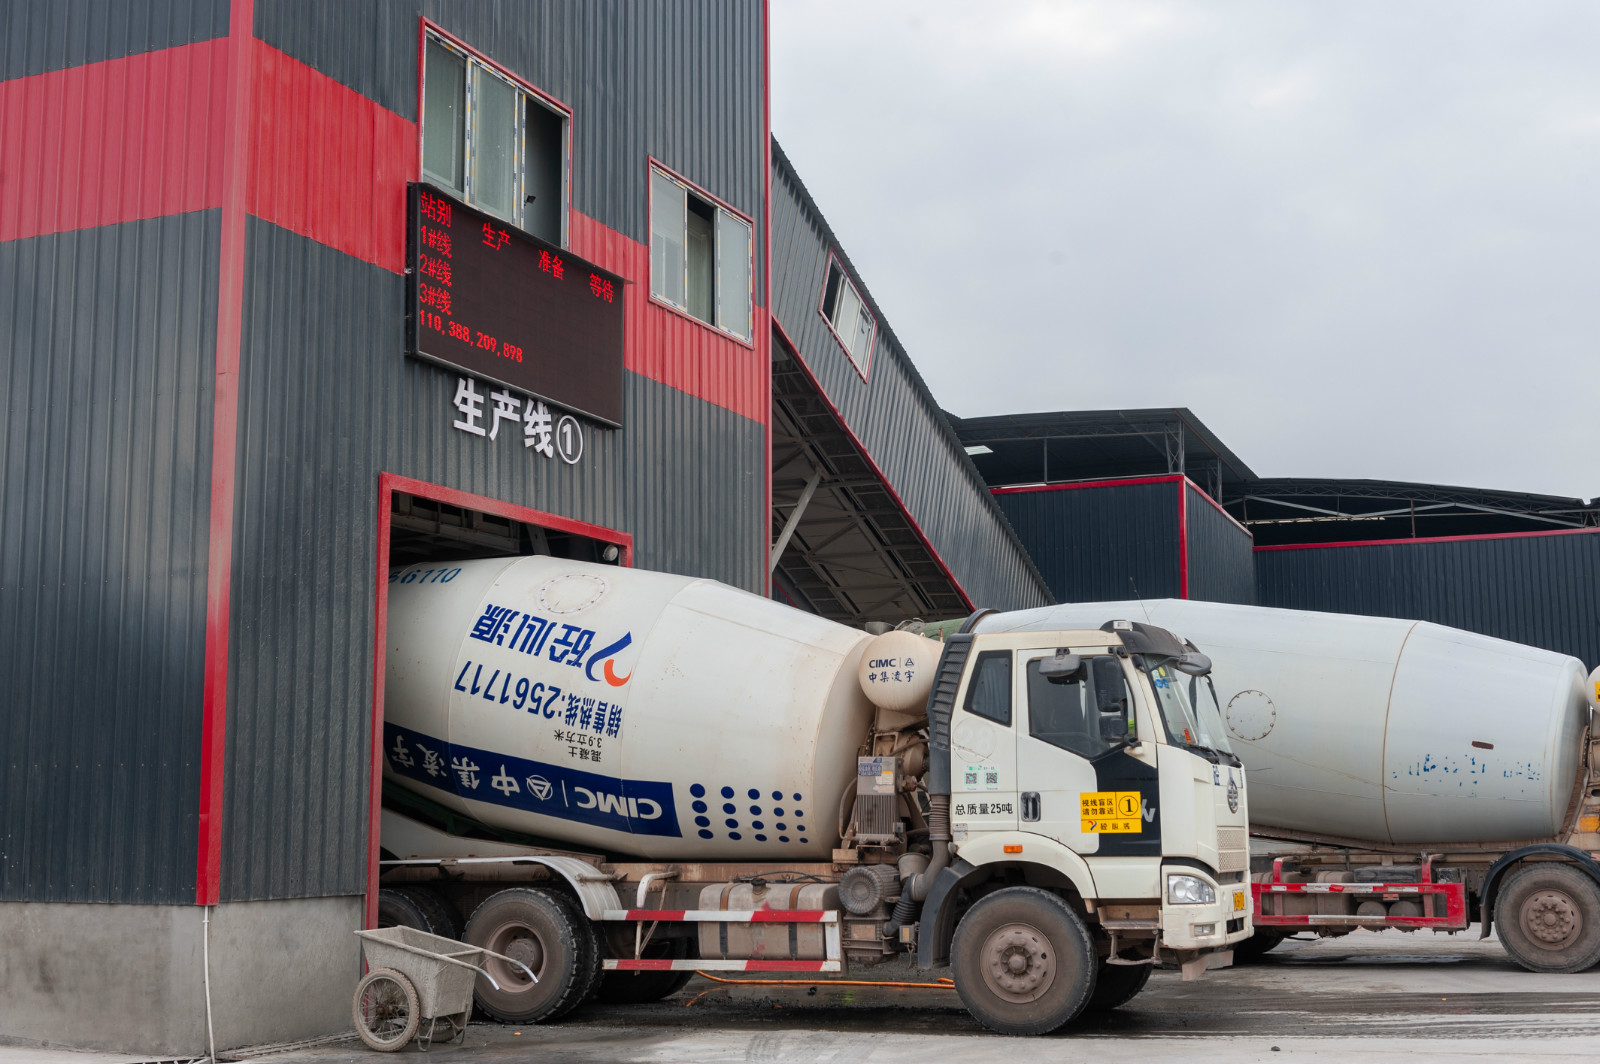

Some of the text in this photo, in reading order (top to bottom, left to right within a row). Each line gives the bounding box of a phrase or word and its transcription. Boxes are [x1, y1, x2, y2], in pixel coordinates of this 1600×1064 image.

[420, 225, 452, 258] 1#线
[420, 191, 614, 303] 站别 生产 准备 等待
[419, 253, 452, 287] 2#线
[419, 282, 452, 315] 3#线
[868, 658, 896, 668] CIMC
[567, 745, 602, 762] 混凝土
[574, 786, 663, 820] CIMC
[955, 802, 1013, 815] 总质量25吨
